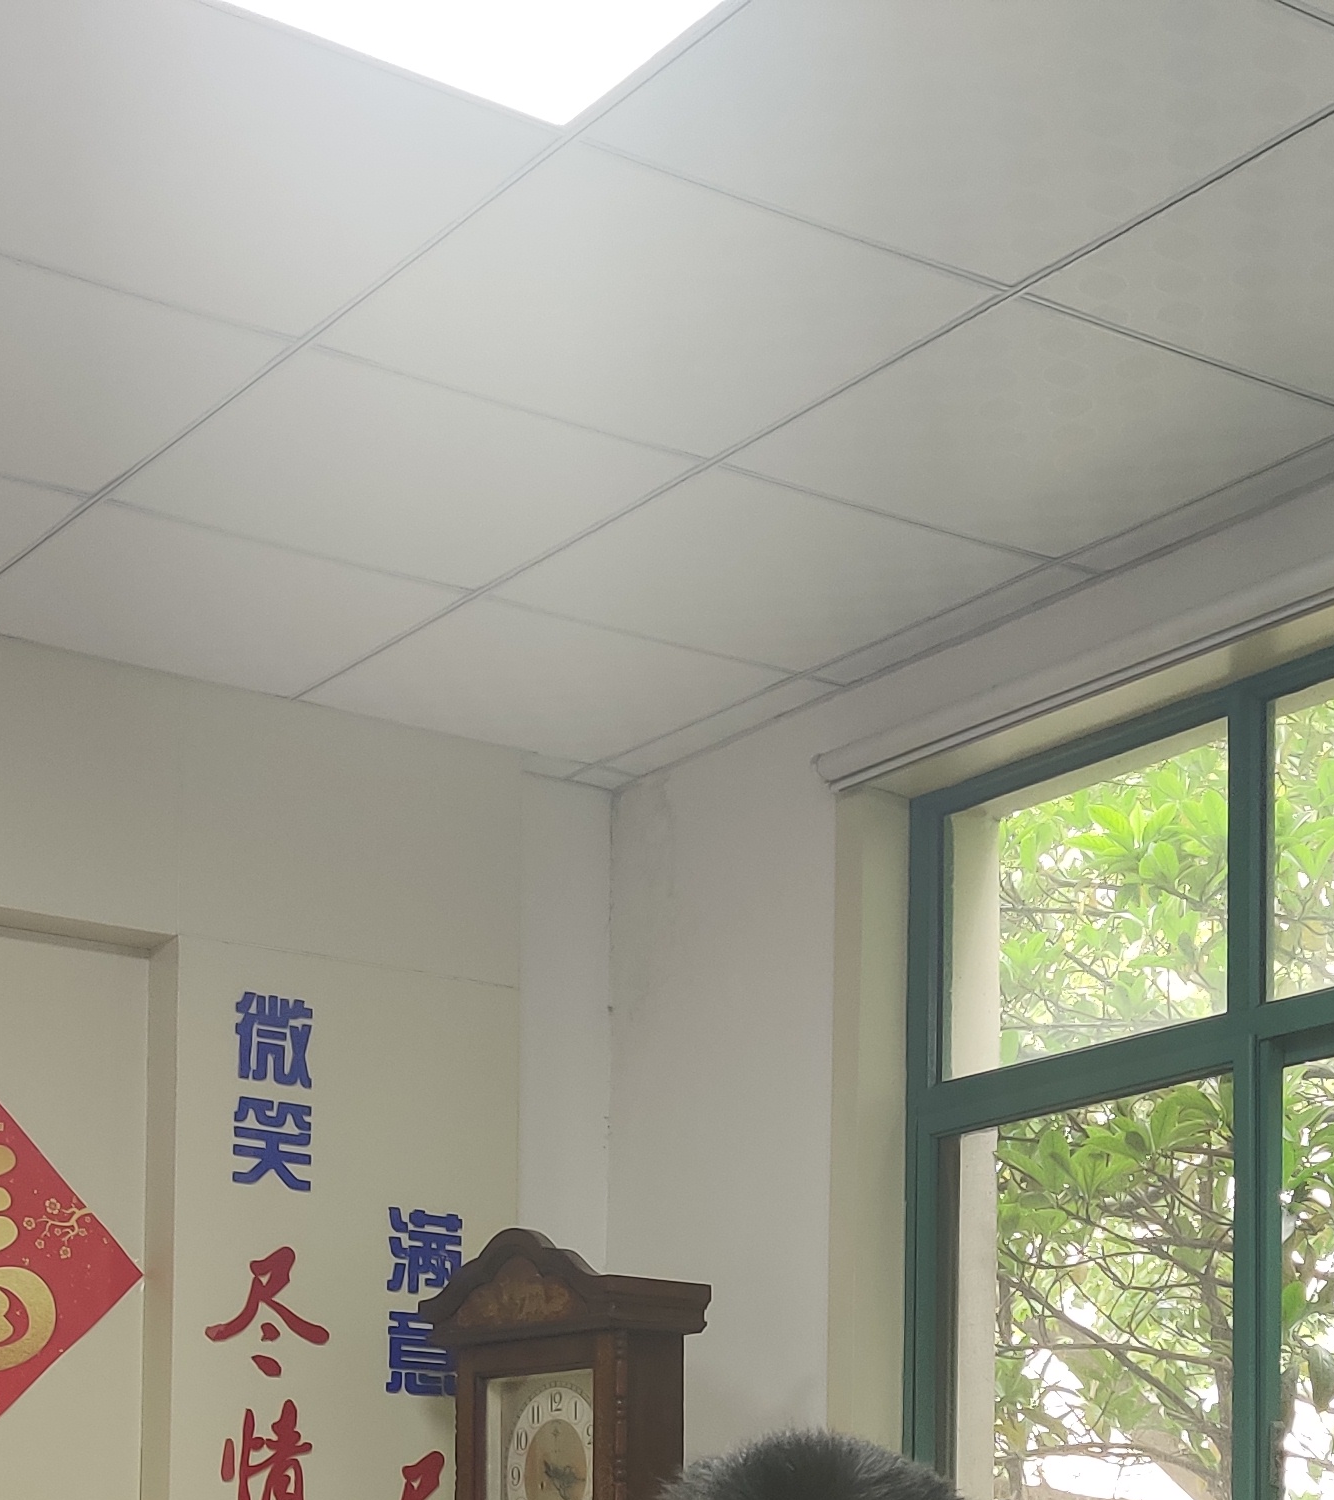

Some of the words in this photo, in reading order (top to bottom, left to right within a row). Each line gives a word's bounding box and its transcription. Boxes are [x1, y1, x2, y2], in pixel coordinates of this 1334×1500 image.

[233, 990, 314, 1192] 微笑
[385, 1206, 463, 1397] 满意
[550, 1391, 563, 1412] 12
[531, 1404, 540, 1425] 11
[517, 1429, 528, 1451] 10
[511, 1466, 521, 1487] 9
